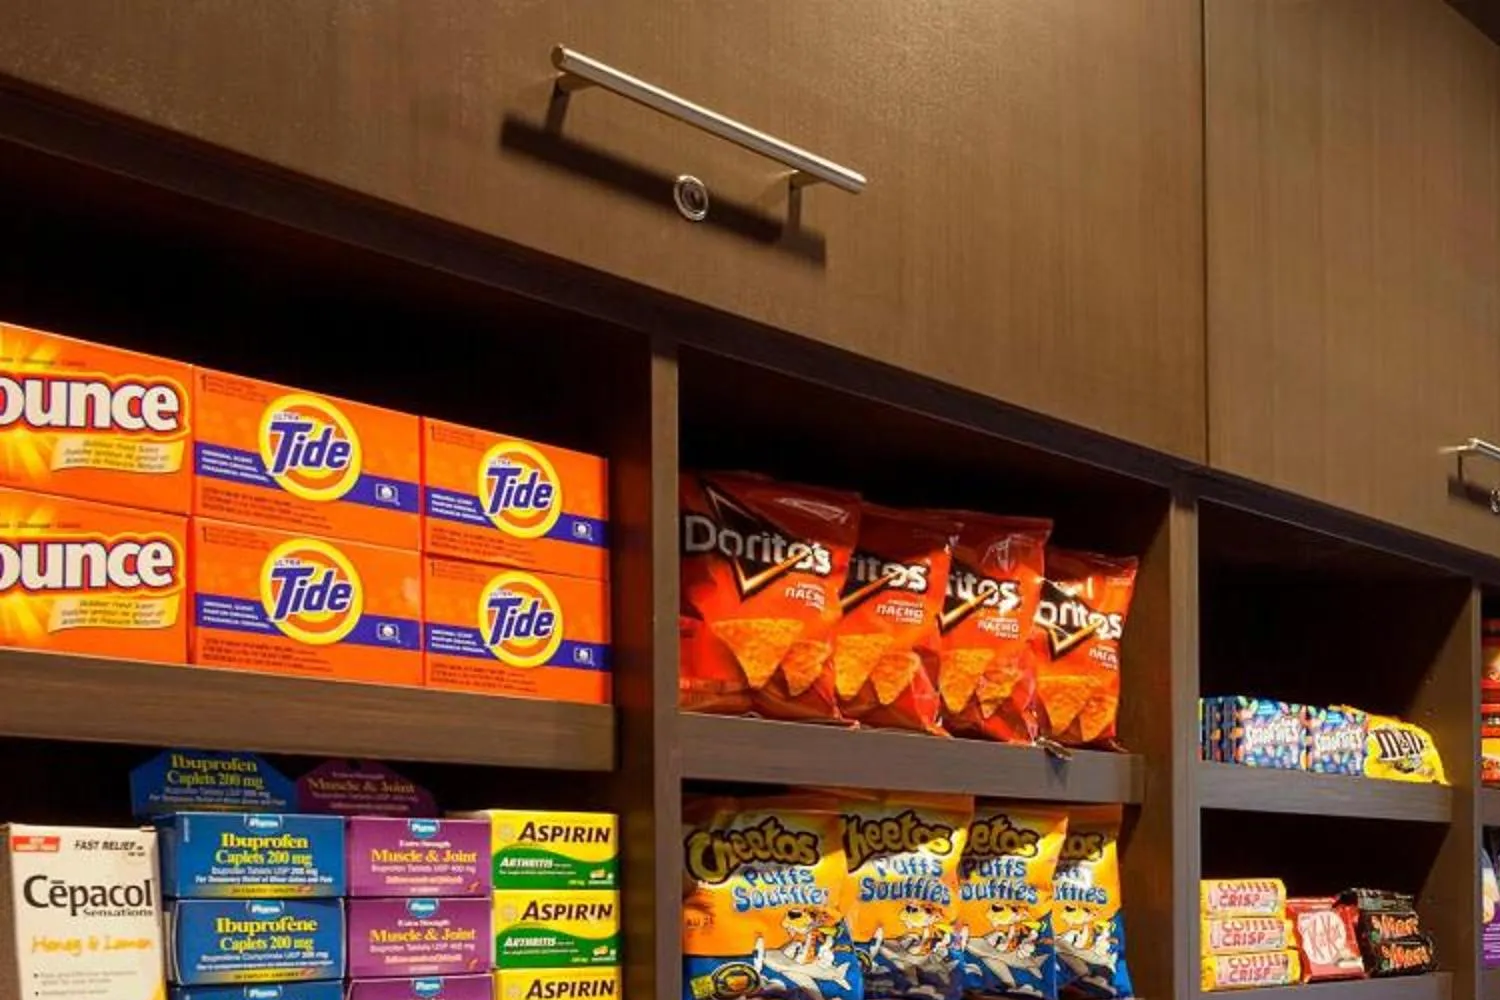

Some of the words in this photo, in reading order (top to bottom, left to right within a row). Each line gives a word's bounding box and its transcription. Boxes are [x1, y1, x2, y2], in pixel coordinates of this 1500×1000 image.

[270, 421, 352, 475] Tide
[487, 467, 553, 515] Tide
[684, 514, 832, 575] Doritos
[271, 566, 353, 620] Tide
[876, 603, 924, 619] NACHO
[1034, 599, 1123, 640] oritos
[487, 597, 555, 646] Tide
[977, 619, 1020, 634] NACHO
[171, 754, 257, 773] Ibuprofen
[167, 772, 219, 789] Caplets
[220, 773, 242, 787] 200
[243, 776, 263, 790] mg
[518, 821, 611, 843] ASPIRIN
[843, 809, 954, 874] heetos
[74, 840, 99, 852] FAST
[101, 840, 136, 852] RELIEF
[221, 832, 308, 852] Ibuprofen
[684, 816, 821, 885] Cheetos
[215, 849, 265, 866] Caplets
[267, 850, 289, 864] 200
[291, 853, 312, 867] mg
[371, 848, 422, 862] Muscle
[425, 848, 438, 862] &
[443, 849, 477, 862] Joint
[743, 866, 815, 887] Puffs
[874, 856, 944, 879] Puffs
[961, 857, 1027, 881] Puffs
[1217, 880, 1279, 894] COFFEE
[1218, 893, 1262, 907] CRISP
[83, 908, 153, 918] Sensations
[521, 900, 613, 921] ASPIRIN
[370, 928, 421, 943] Muscle
[424, 927, 438, 941] &
[441, 927, 476, 941] Joint
[1221, 918, 1285, 934] COFFEE
[219, 936, 267, 953] Caplets
[270, 936, 291, 950] 200
[293, 938, 315, 953] mg
[1221, 932, 1266, 947] CRISP
[1227, 953, 1289, 969] COFFEE
[1227, 967, 1270, 983] CRISP
[525, 978, 615, 999] ASPIRIN
